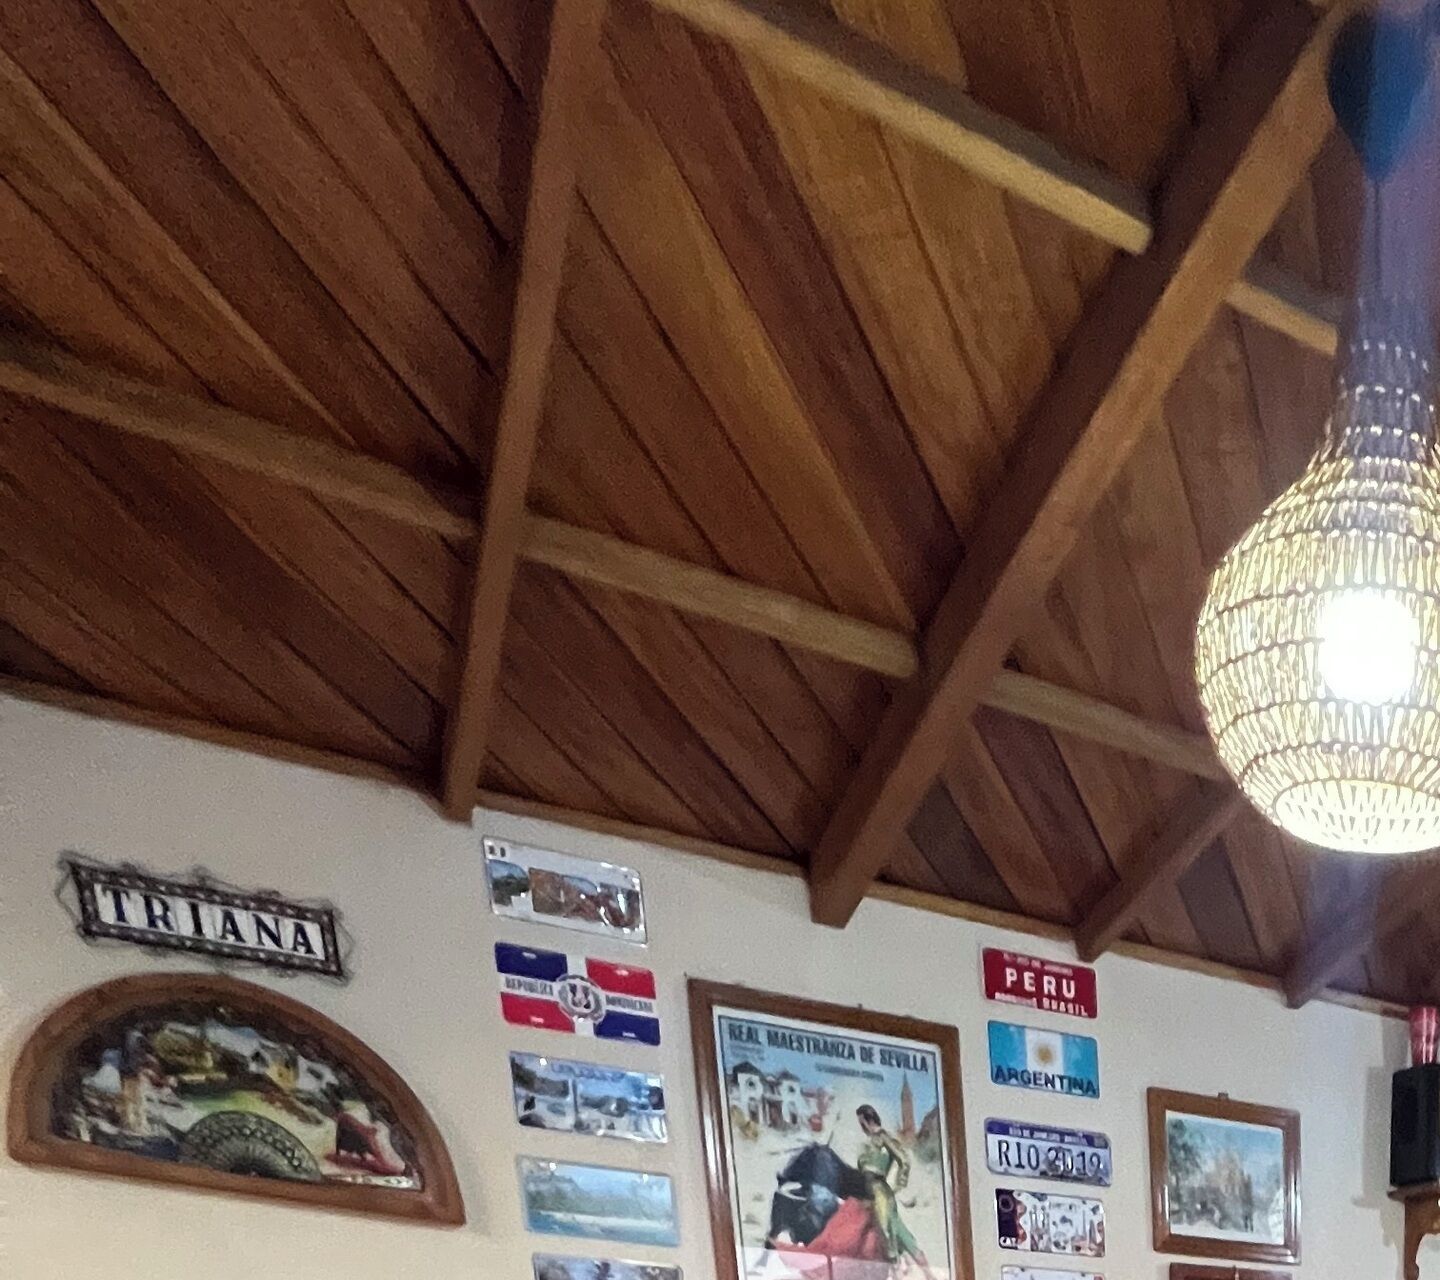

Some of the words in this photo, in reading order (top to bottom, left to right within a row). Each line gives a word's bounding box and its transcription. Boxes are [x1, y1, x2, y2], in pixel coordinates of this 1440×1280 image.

[102, 883, 316, 955] TRIANA
[1005, 966, 1076, 999] PERU
[727, 1022, 761, 1046] REAL
[766, 1028, 856, 1062] MAESTRANZA
[860, 1047, 875, 1064] DE
[879, 1047, 929, 1073] SEVILLA
[994, 1064, 1097, 1095] ARGENTINA
[997, 1139, 1041, 1171] RIO
